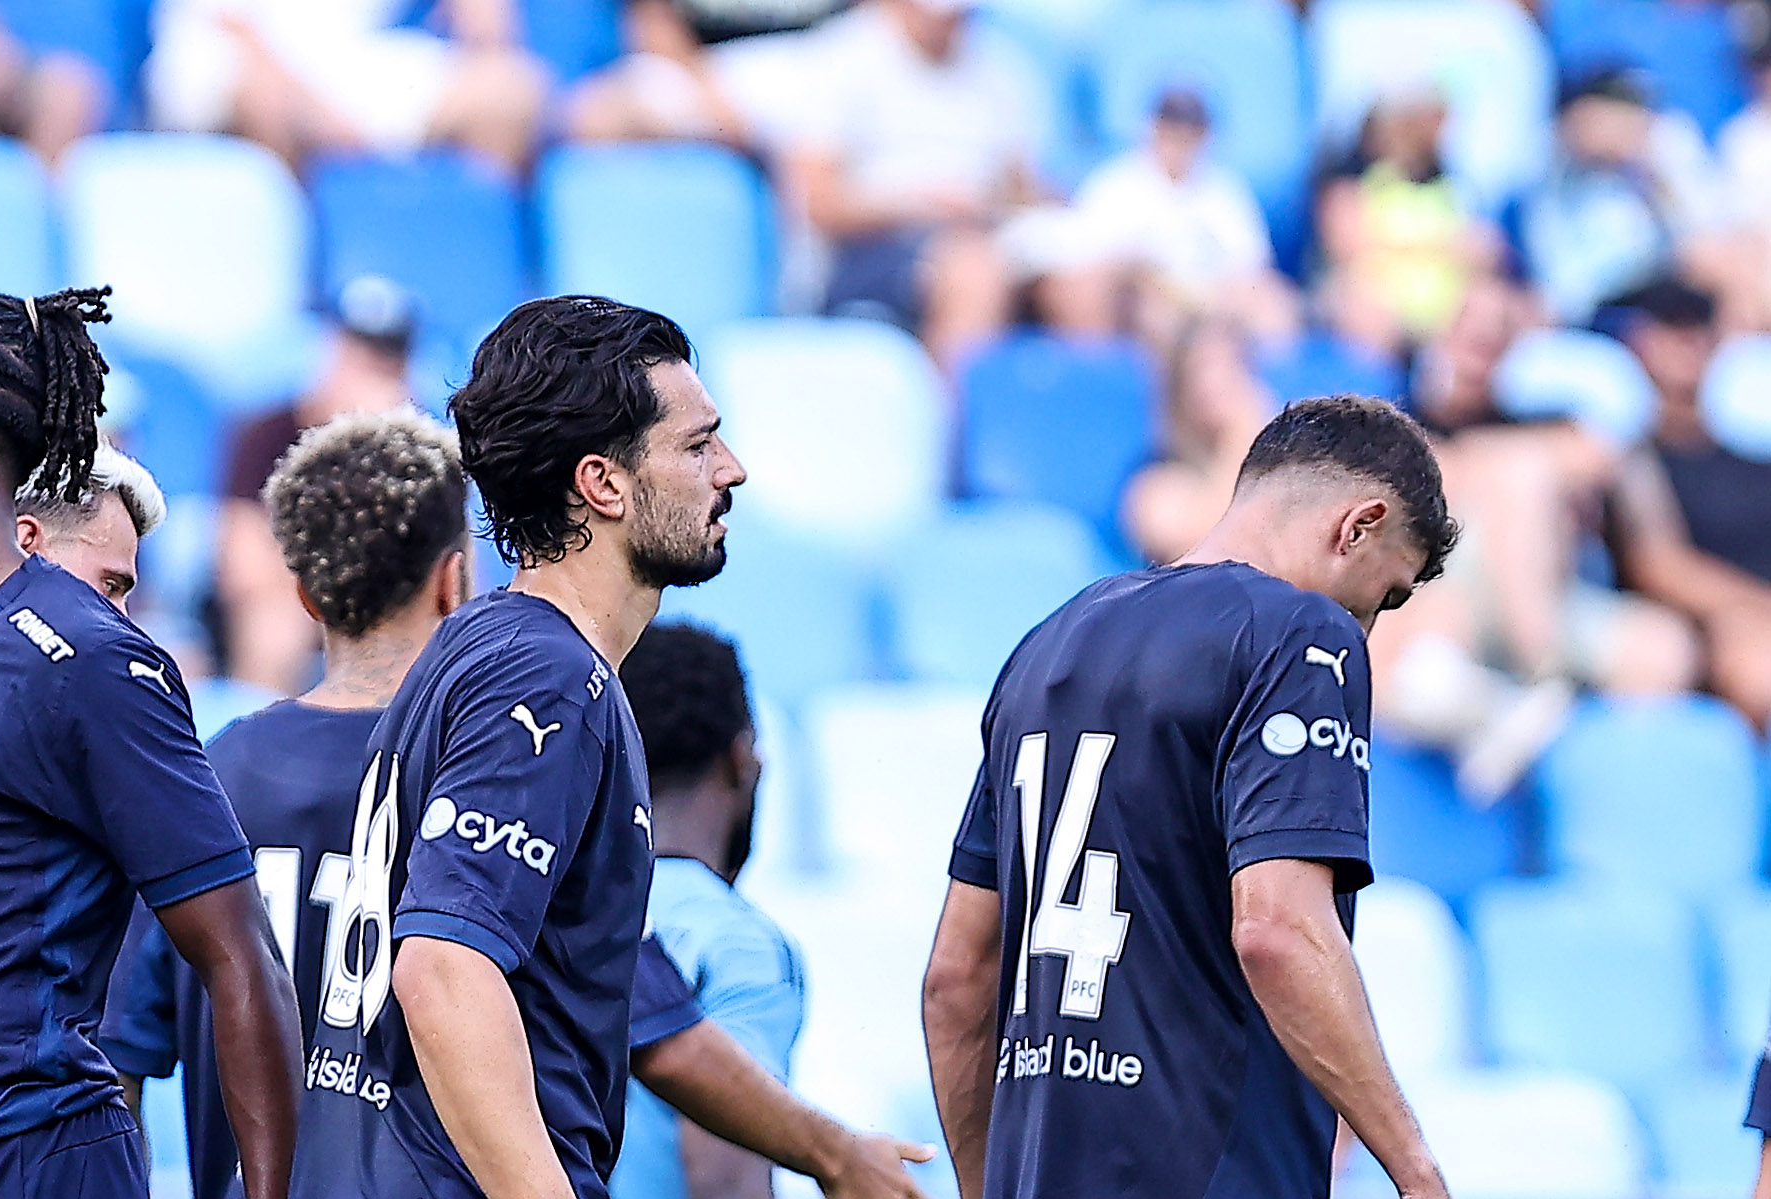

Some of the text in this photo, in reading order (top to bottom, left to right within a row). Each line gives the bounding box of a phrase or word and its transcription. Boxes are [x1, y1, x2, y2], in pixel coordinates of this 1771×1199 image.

[8, 608, 75, 662] FONBET
[456, 810, 557, 876] cyta
[1011, 731, 1131, 1022] 14
[1070, 980, 1098, 998] PFC
[1062, 1036, 1143, 1086] blue
